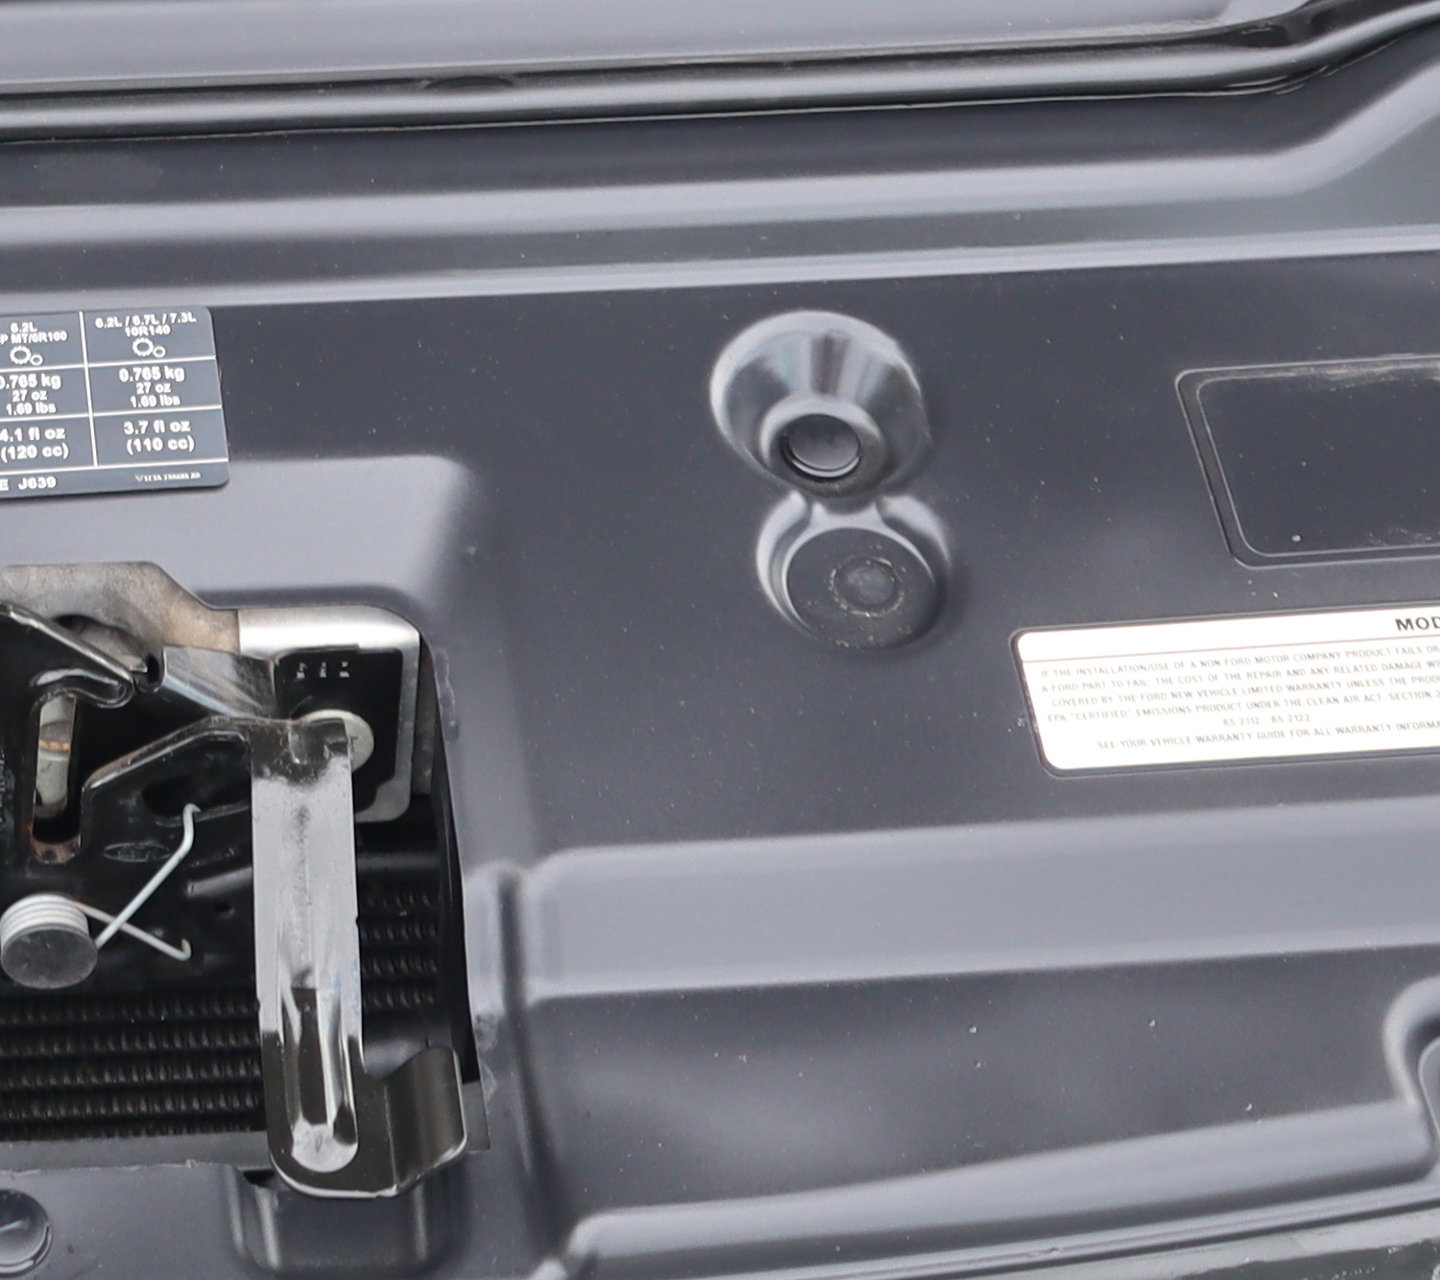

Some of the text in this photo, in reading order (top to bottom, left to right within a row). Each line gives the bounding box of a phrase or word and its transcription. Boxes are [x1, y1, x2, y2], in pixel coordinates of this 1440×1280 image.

[42, 374, 61, 389] kg
[119, 366, 185, 382] 0.765 kg
[12, 390, 47, 401] 27 oz
[136, 383, 171, 394] 27 oz
[6, 402, 56, 415] 1.69 lbs
[130, 395, 180, 408] 1.69 lbs
[28, 428, 40, 440] fl
[45, 428, 66, 439] oz
[123, 420, 191, 435] 3.7 fl oz
[126, 435, 195, 455] (110 cc)
[1, 443, 69, 463] (120 cc)
[1345, 648, 1390, 658] PRODUCT
[1287, 668, 1306, 676] AND
[1311, 667, 1329, 675] ANY
[1334, 664, 1377, 673] RELATED
[1171, 691, 1192, 699] NEW
[1197, 688, 1236, 697] VEHICLE
[1242, 685, 1282, 694] LIMITED
[1286, 681, 1341, 691] WARRANTY
[1347, 679, 1384, 688] UNLESS
[1136, 706, 1192, 716] EMISSIONS
[1196, 703, 1241, 712] PRODUCT
[1247, 700, 1280, 709] UNDER
[1196, 733, 1251, 743] WARRANTY
[1335, 724, 1391, 734] WARRANTY
